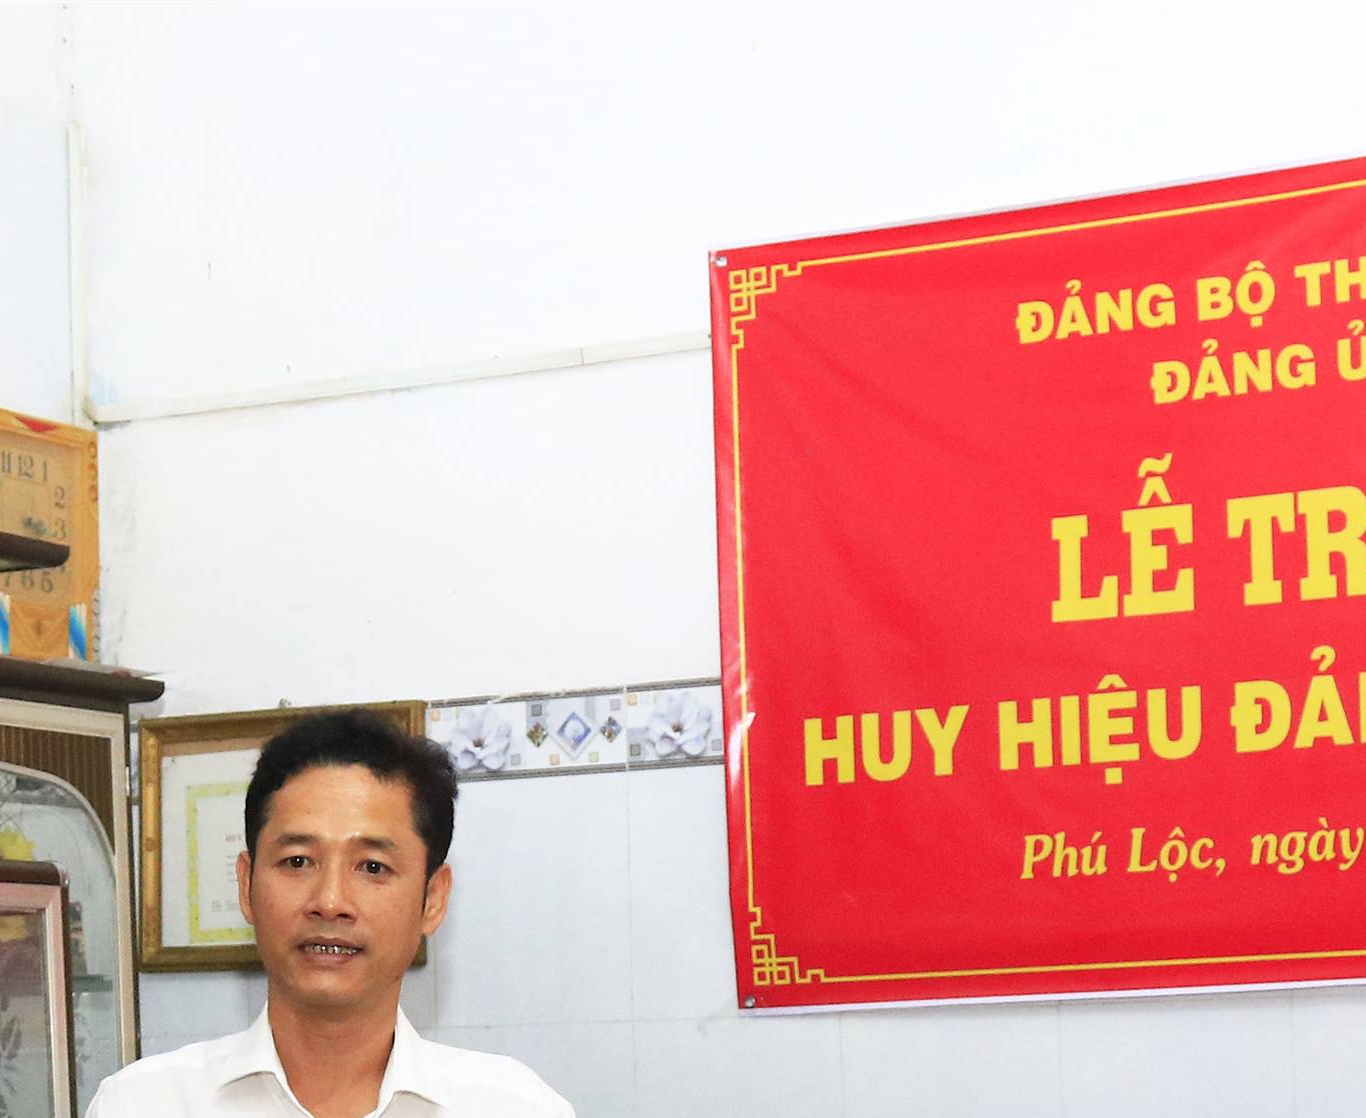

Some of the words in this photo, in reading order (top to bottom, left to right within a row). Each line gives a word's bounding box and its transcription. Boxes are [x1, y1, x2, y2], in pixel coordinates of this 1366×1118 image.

[1016, 281, 1175, 343] ĐẢNG
[1198, 262, 1274, 326] BỘ
[1152, 340, 1315, 403] ĐẢNG
[54, 486, 65, 510] 2
[1052, 455, 1193, 621] LỄ
[806, 706, 967, 784] HUY
[1000, 675, 1200, 783] HIỆU
[1023, 833, 1105, 878] Phú
[1129, 829, 1225, 880] Lộc,
[1253, 819, 1363, 873] ngày
